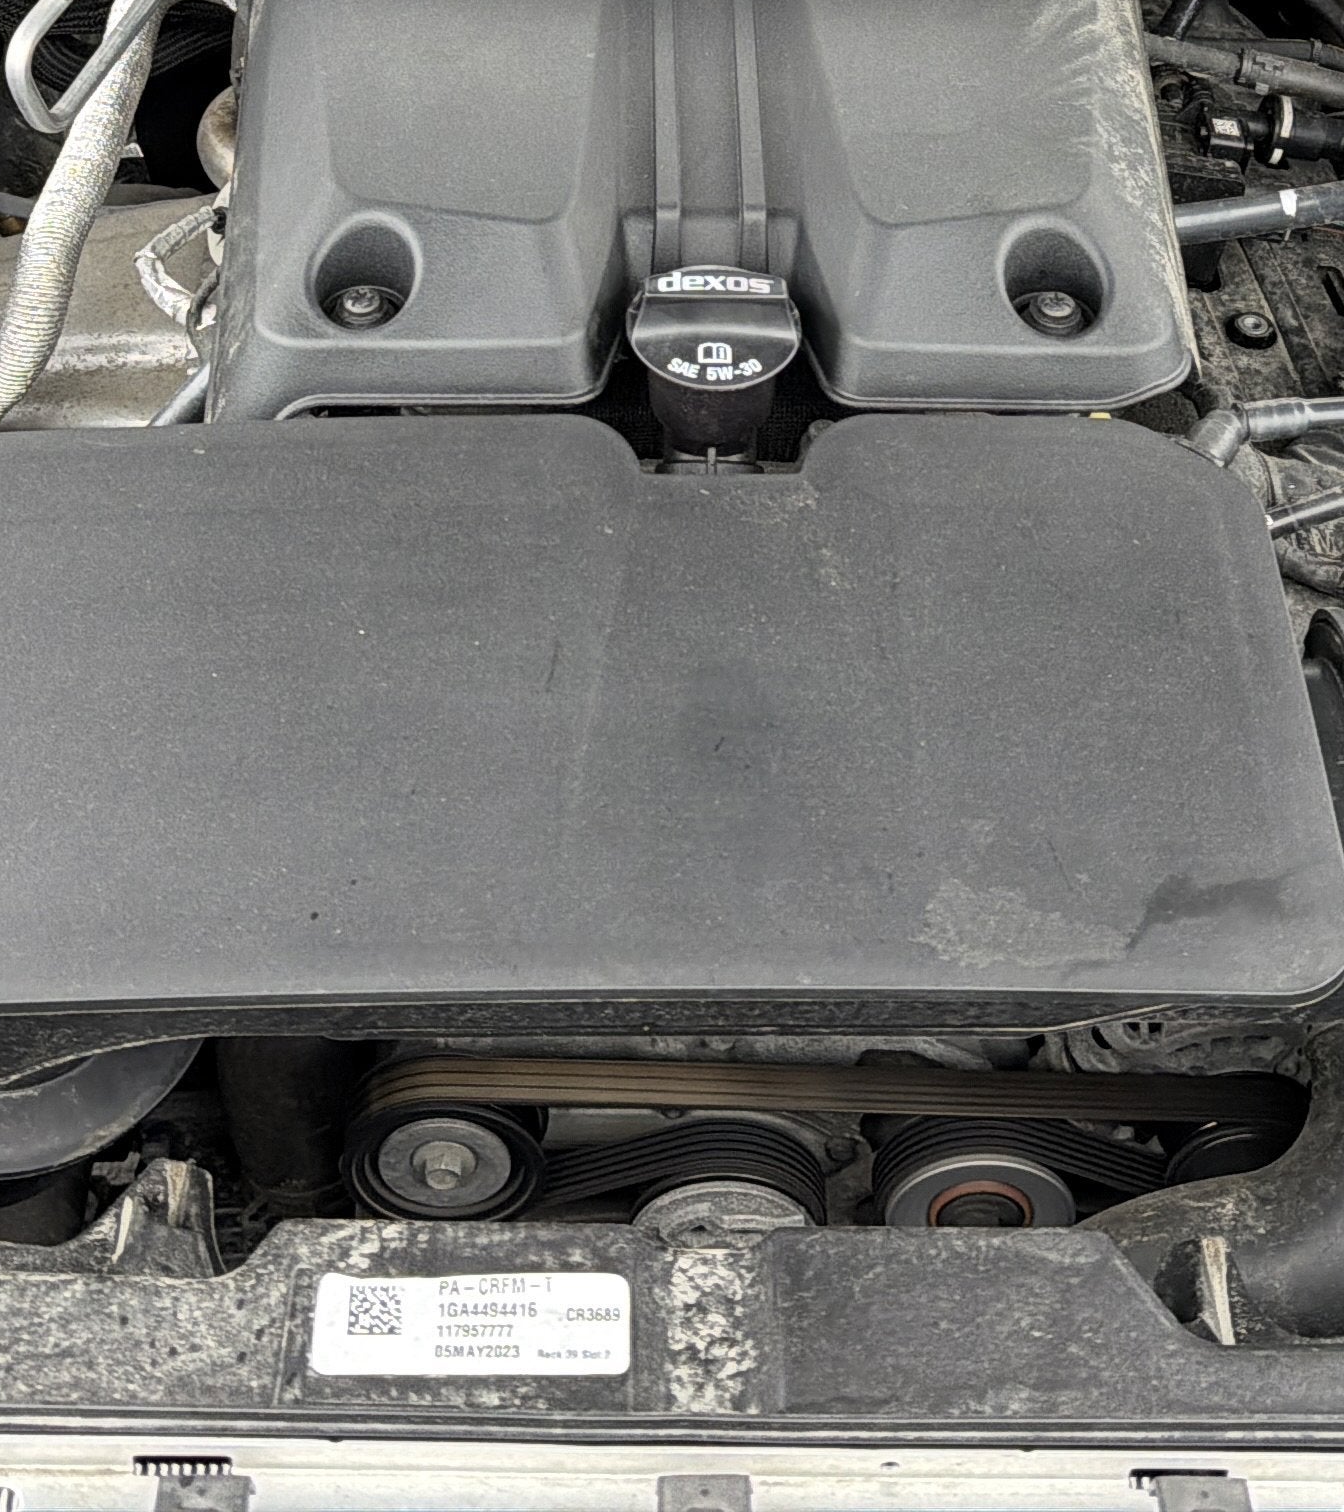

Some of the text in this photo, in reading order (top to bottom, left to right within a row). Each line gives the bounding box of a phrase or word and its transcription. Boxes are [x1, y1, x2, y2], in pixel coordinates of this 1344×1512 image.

[658, 272, 775, 294] dexos
[667, 357, 763, 381] SAE 5W-30
[566, 1307, 621, 1321] CR3689
[435, 1345, 520, 1358] 05MAY2023
